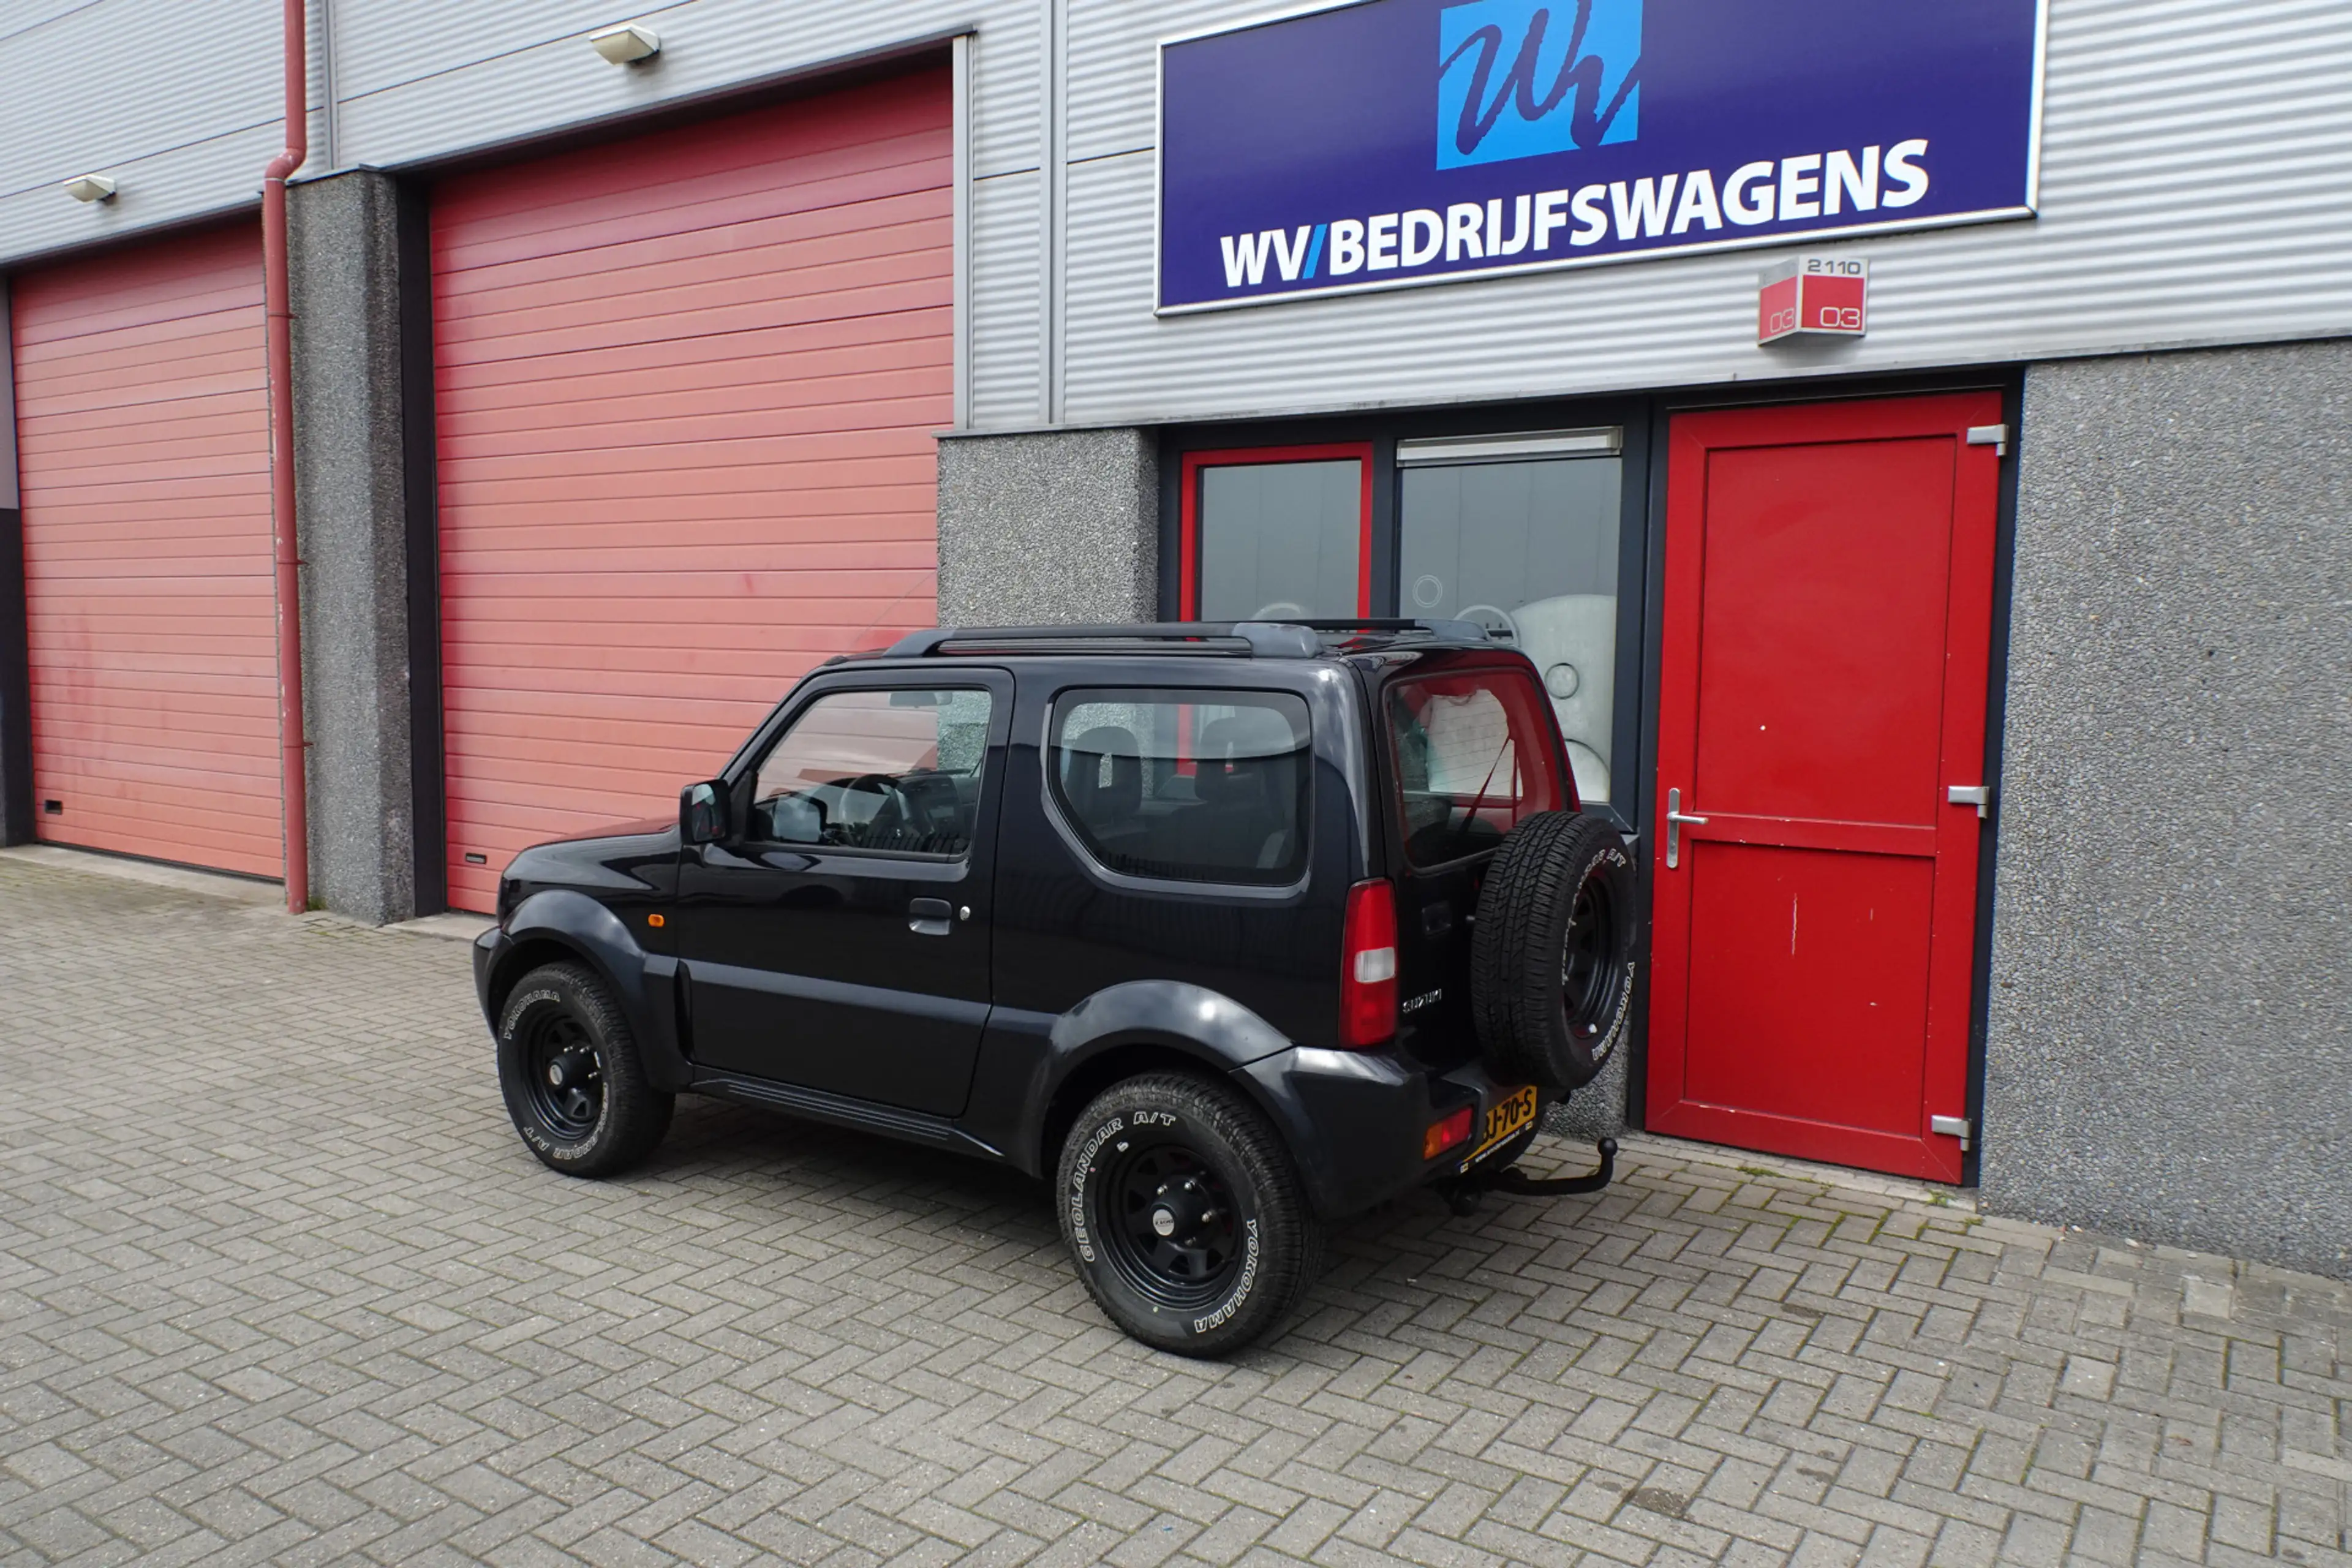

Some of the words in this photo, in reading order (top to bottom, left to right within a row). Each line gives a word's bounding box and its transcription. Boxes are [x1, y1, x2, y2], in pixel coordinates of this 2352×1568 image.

[1807, 258, 1861, 275] 2110
[1770, 307, 1795, 334] 03
[1820, 306, 1861, 328] 03
[1071, 1118, 1124, 1262] GEOLANDAR
[1133, 1111, 1176, 1126] A/T
[1194, 1219, 1260, 1333] YOKOHAMA
